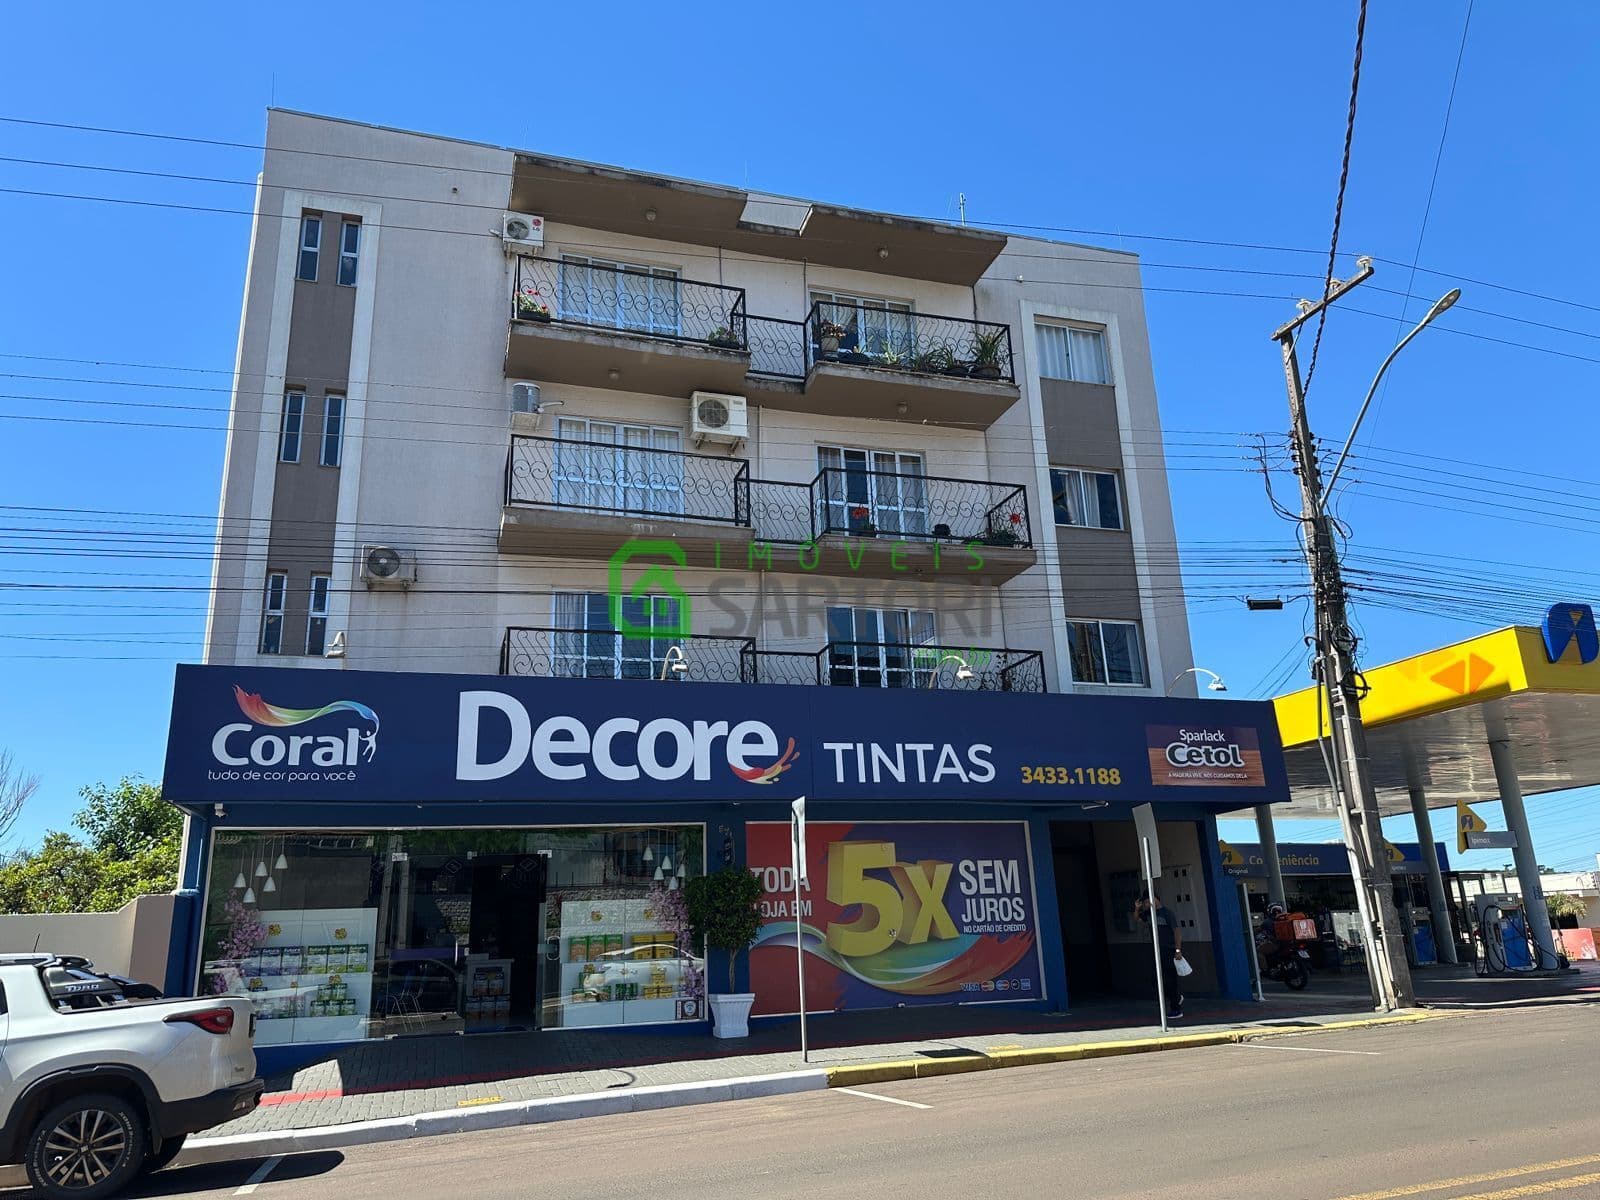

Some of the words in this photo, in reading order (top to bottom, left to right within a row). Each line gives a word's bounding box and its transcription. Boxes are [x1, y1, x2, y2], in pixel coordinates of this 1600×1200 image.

[212, 722, 360, 767] Coral
[456, 690, 779, 782] Decore
[1179, 729, 1226, 743] Sparlack
[823, 742, 997, 783] TINTAS
[1166, 742, 1245, 767] Cetol
[208, 769, 240, 780] tudo
[242, 769, 261, 780] de
[263, 771, 286, 780] cor
[287, 771, 320, 782] para
[323, 770, 356, 781] você
[1020, 766, 1121, 785] 3433.1188
[959, 859, 1021, 895] SEM
[961, 897, 1026, 923] JUROS
[963, 925, 972, 933] NO
[972, 923, 994, 933] CARTÃO
[995, 924, 1002, 932] DE
[1003, 923, 1026, 932] CRÉDITO
